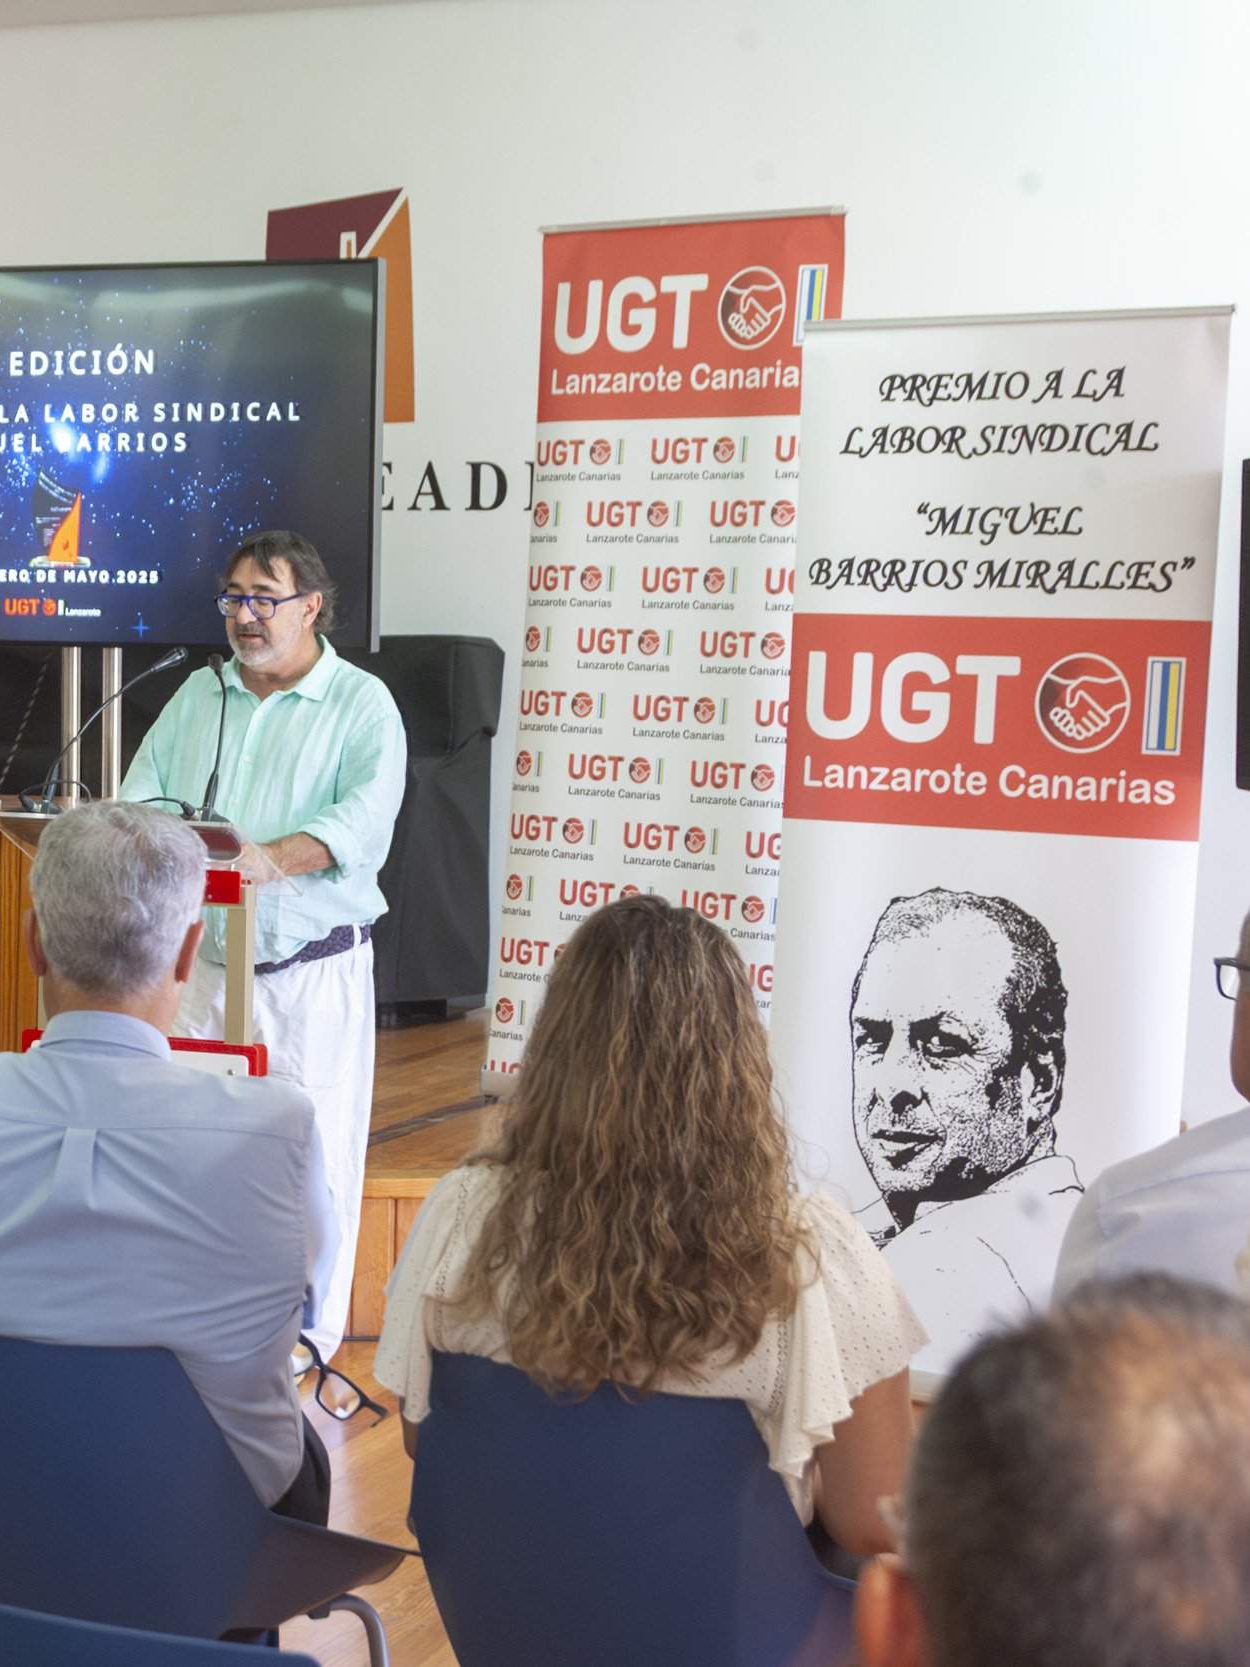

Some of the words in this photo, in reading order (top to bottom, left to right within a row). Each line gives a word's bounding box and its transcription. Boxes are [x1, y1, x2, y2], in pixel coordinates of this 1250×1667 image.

[553, 273, 708, 355] UGT
[9, 344, 154, 376] EDICIÓN
[550, 365, 681, 395] Lanzarote
[879, 371, 1030, 405] PREMIO
[1032, 367, 1064, 403] A
[1072, 365, 1127, 401] LA
[44, 402, 139, 424] LABOR
[154, 402, 300, 422] SINDICAL
[537, 440, 585, 466] UGT
[651, 437, 708, 464] UGT
[840, 425, 974, 460] LABOR
[969, 422, 1159, 459] SINDICAL
[579, 472, 621, 481] Canarias
[651, 470, 699, 480] Lanzarote
[702, 470, 745, 480] Canarias
[586, 501, 642, 527] UGT
[710, 500, 766, 527] UGT
[586, 534, 634, 543] Lanzarote
[636, 534, 679, 543] Canarias
[710, 534, 756, 544] Lanzarote
[36, 569, 56, 584] DE
[529, 565, 576, 591] UGT
[642, 566, 699, 593] UGT
[808, 557, 968, 592] BARRIOS
[4, 598, 40, 618] UGT
[570, 598, 612, 608] Canarias
[642, 600, 689, 609] Lanzarote
[692, 600, 734, 610] Canarias
[577, 628, 633, 654] UGT
[700, 631, 756, 658] UGT
[577, 660, 624, 670] Lanzarote
[627, 661, 670, 672] Canarias
[700, 664, 746, 675] Lanzarote
[521, 689, 566, 716] UGT
[633, 695, 689, 722] UGT
[805, 650, 1021, 745] UGT
[561, 723, 602, 734] Canarias
[633, 728, 680, 738] Lanzarote
[683, 730, 725, 741] Canarias
[568, 753, 624, 781] UGT
[690, 760, 746, 789] UGT
[804, 755, 987, 796] Lanzarote
[999, 764, 1175, 805] Canarias
[568, 786, 615, 797] Lanzarote
[618, 788, 660, 800] Canarias
[690, 794, 737, 806] Lanzarote
[511, 813, 558, 841] UGT
[623, 822, 679, 851] UGT
[552, 849, 594, 861] Canarias
[623, 855, 671, 867] Lanzarote
[673, 859, 716, 871] Canarias
[559, 879, 615, 907] UGT
[500, 937, 549, 966] UGT
[499, 968, 541, 982] Lanzarote
